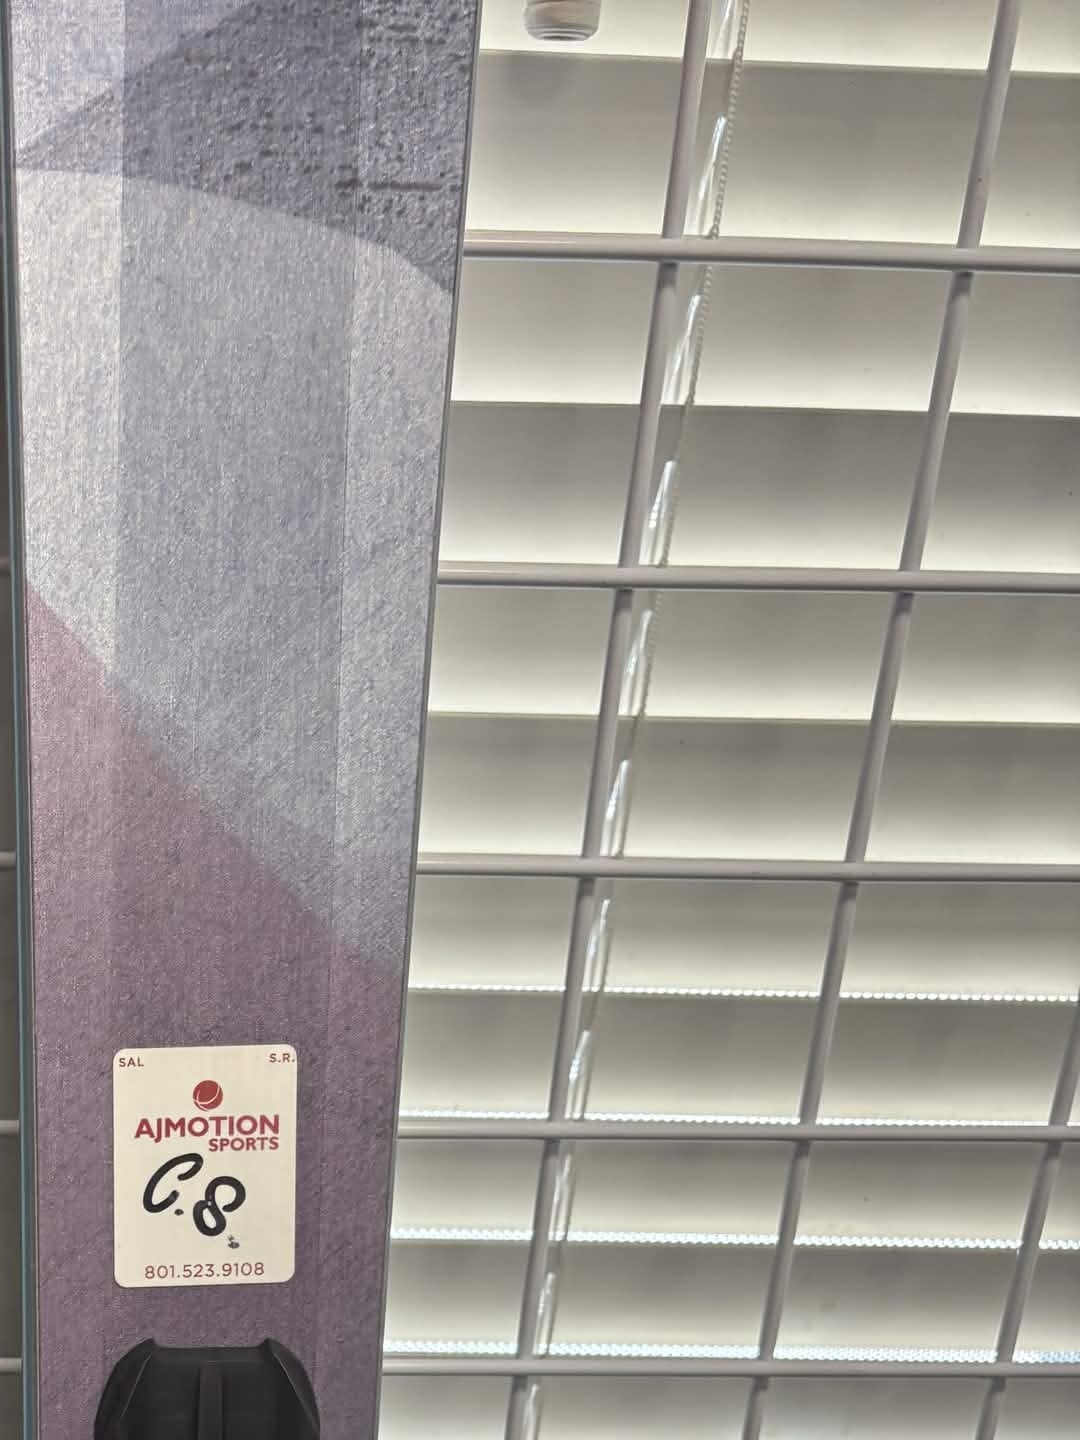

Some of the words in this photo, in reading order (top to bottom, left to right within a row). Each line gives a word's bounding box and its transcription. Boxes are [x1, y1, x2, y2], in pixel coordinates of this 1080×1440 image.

[119, 1057, 145, 1068] SAL
[134, 1114, 280, 1144] AJMOTION
[208, 1136, 280, 1152] SPORTS
[144, 1262, 265, 1280] 801.523.9108
